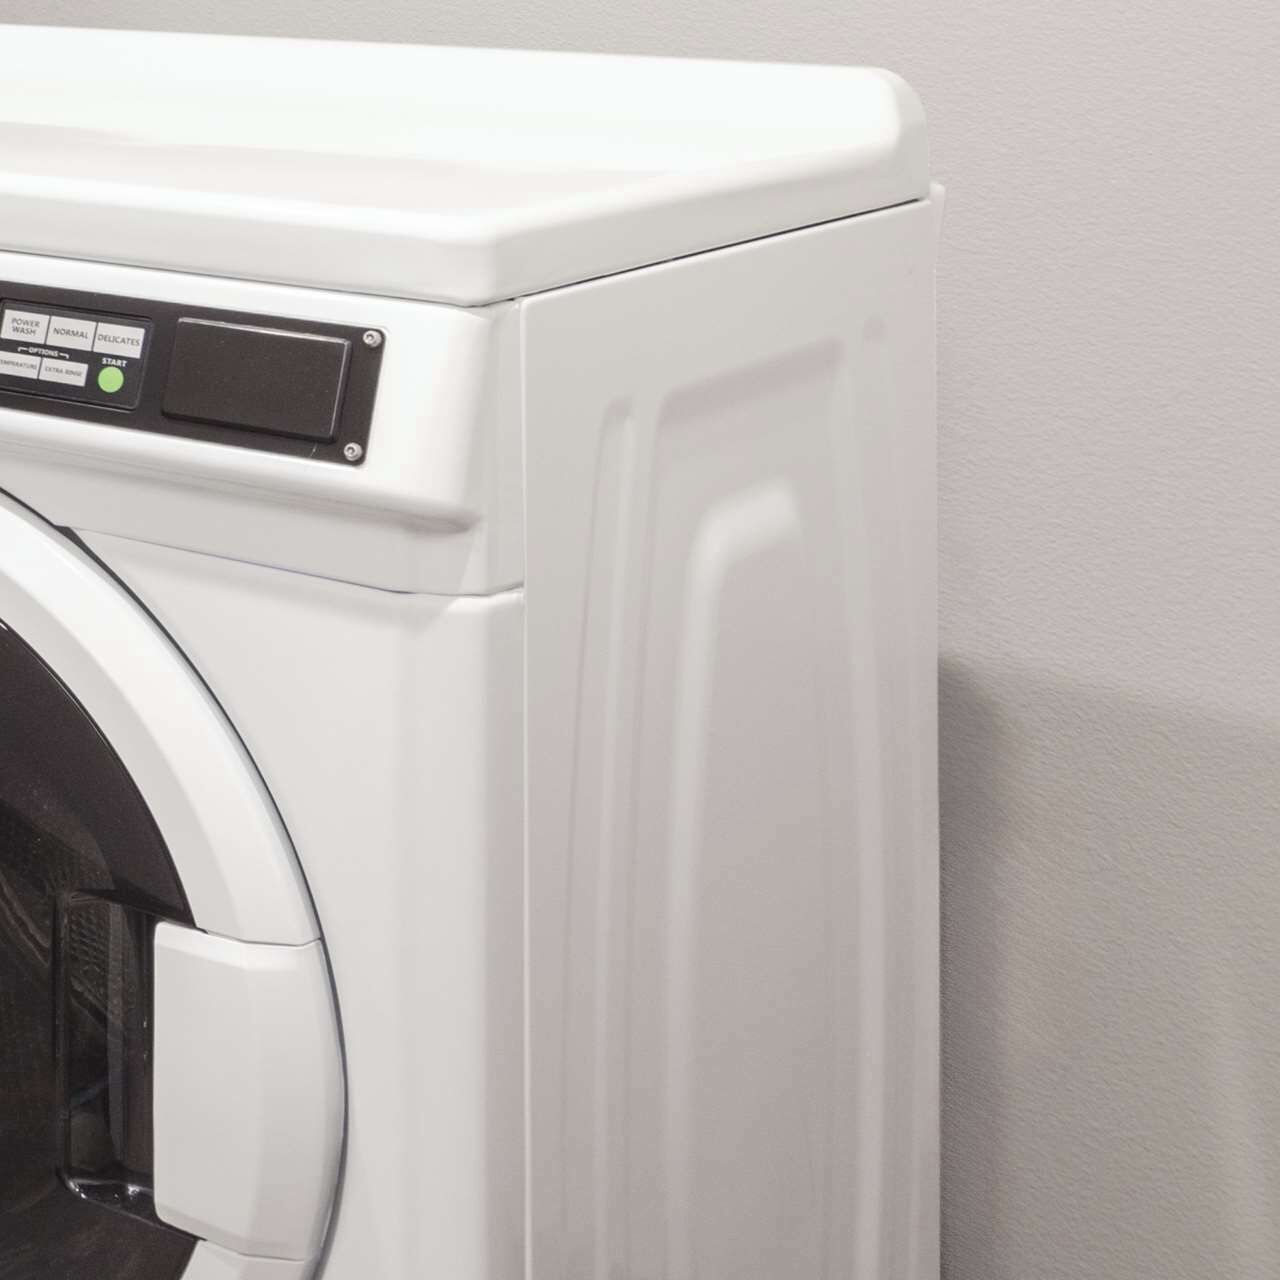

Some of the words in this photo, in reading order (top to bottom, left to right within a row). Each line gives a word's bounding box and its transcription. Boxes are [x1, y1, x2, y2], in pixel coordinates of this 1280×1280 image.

[11, 317, 41, 328] POWER
[11, 326, 37, 336] WASH
[53, 327, 89, 339] NORMAL
[97, 334, 141, 347] DELICATES
[28, 347, 59, 357] OPTIONS
[102, 357, 128, 367] START
[45, 366, 65, 375] EXTRA
